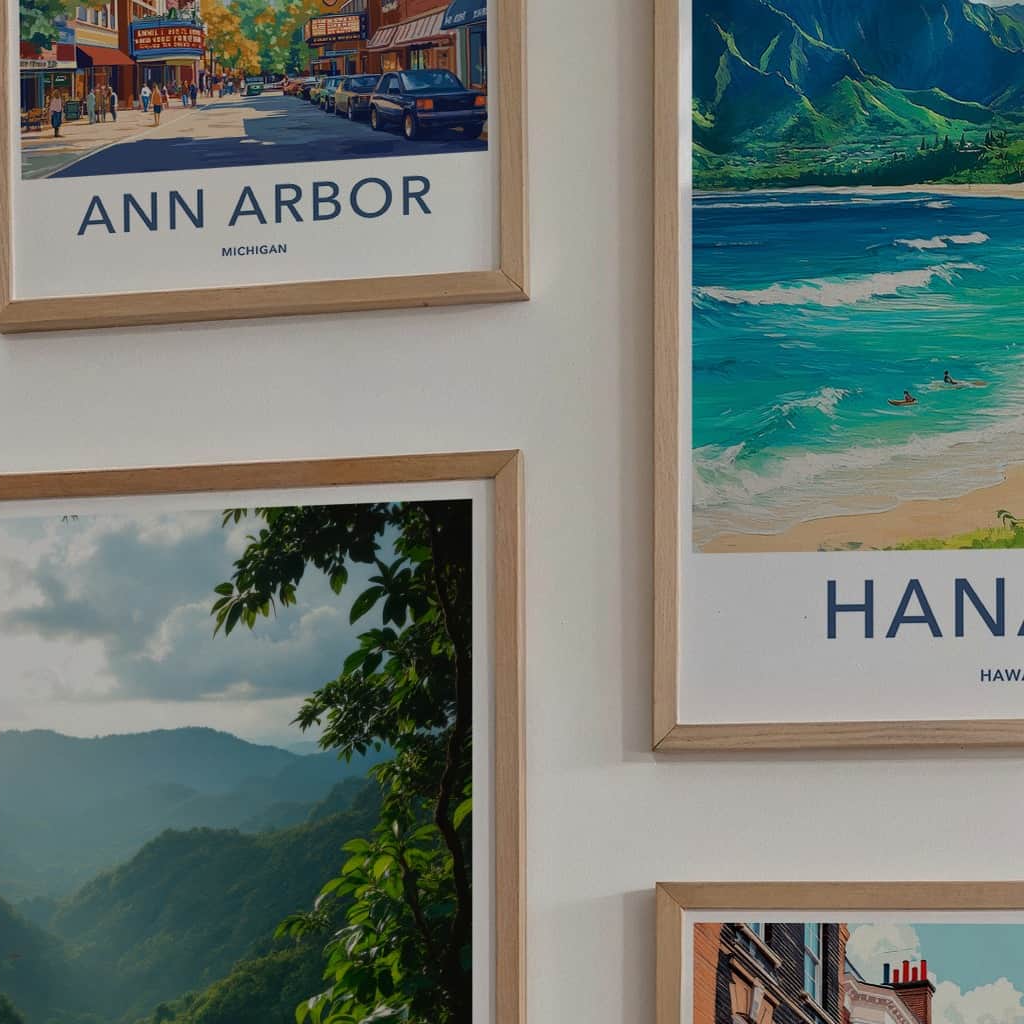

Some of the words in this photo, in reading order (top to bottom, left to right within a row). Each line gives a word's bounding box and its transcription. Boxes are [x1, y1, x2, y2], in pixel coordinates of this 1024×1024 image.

[77, 188, 204, 235] ANN
[229, 175, 432, 226] ARBOR
[221, 243, 288, 257] MICHIGAN
[827, 577, 1024, 639] HAN
